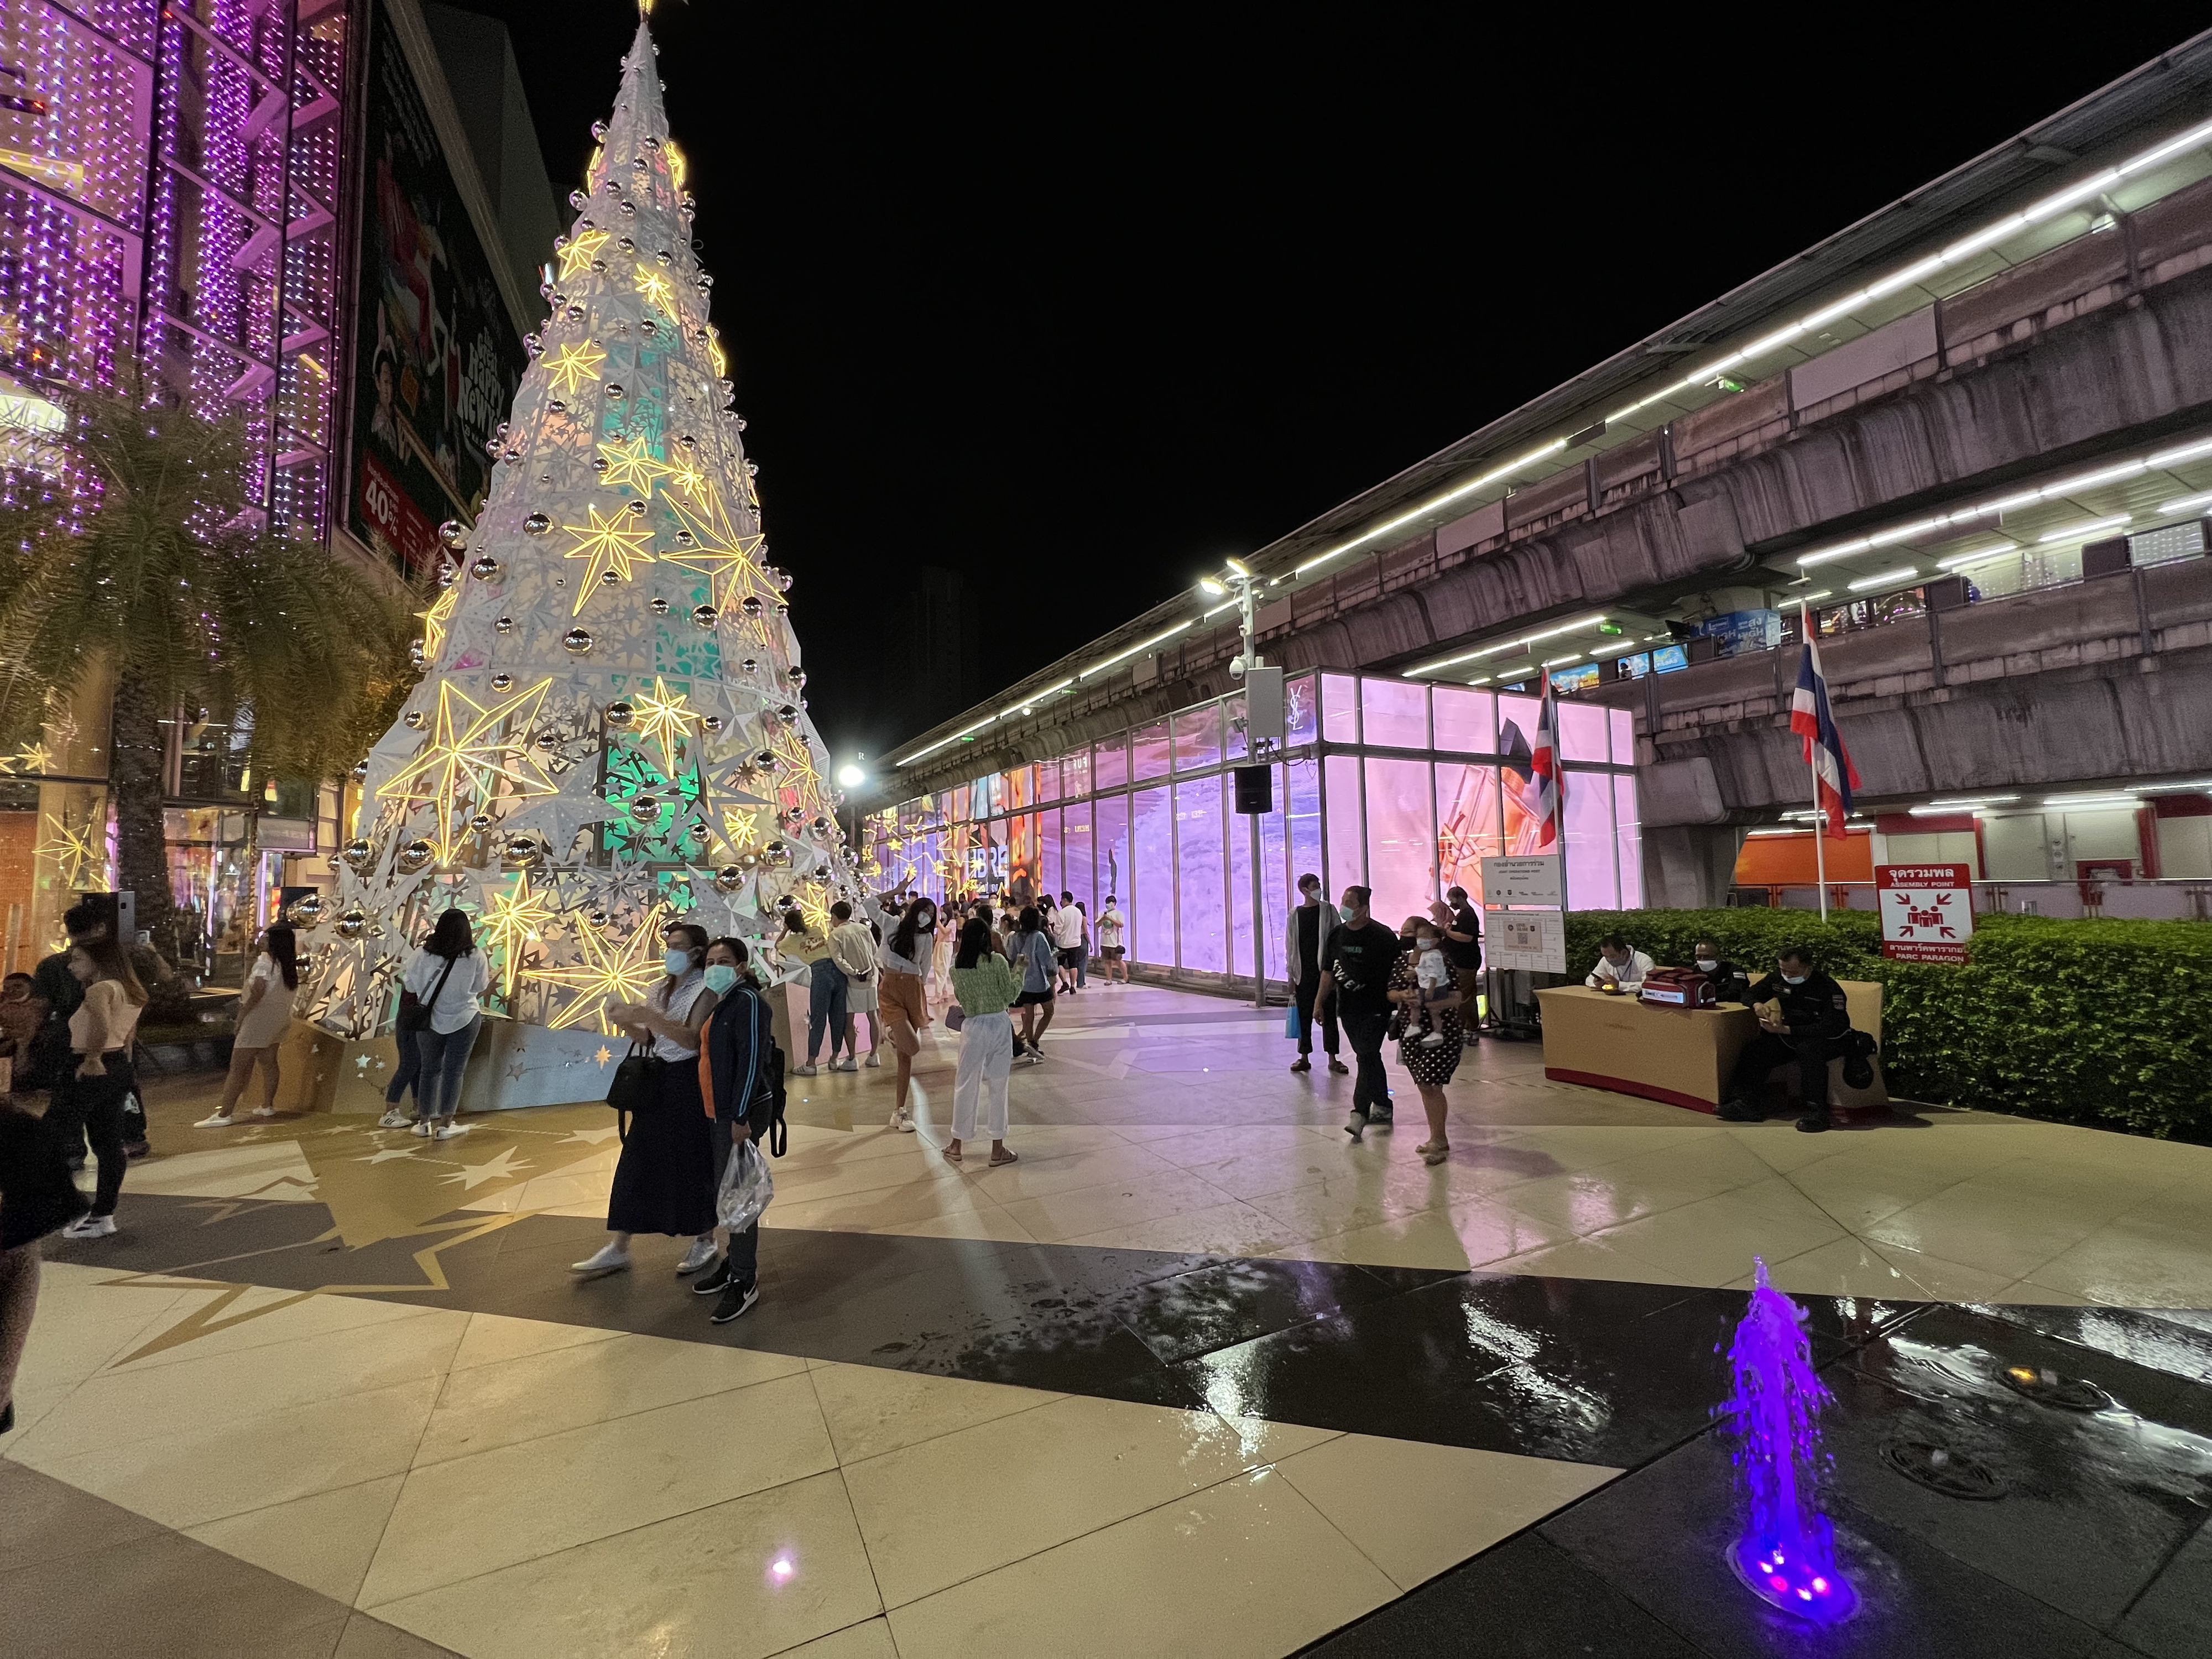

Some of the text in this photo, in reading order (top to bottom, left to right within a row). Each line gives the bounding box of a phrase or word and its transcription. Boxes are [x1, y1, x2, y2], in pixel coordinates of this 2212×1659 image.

[468, 342, 505, 419] Happy
[1289, 685, 1303, 731] YSL
[1888, 868, 1954, 883] จุดรวมพล
[1890, 943, 1966, 953] ลานพาร์คพารากอ
[1921, 953, 1964, 962] PARAGON
